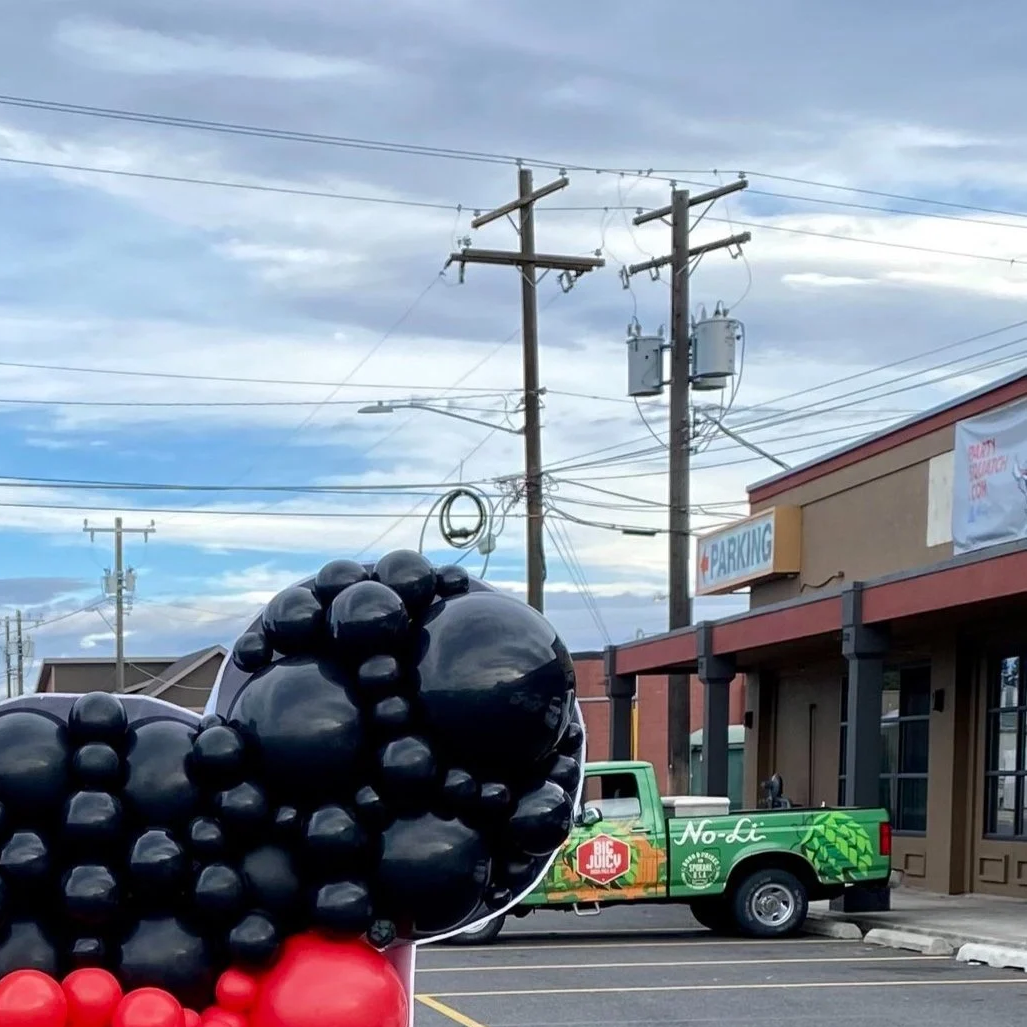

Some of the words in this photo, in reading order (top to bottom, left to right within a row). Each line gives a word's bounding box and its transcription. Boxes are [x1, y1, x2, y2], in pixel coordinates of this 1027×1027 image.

[710, 523, 772, 580] PARKING
[593, 840, 614, 856] BIG
[585, 853, 622, 869] JUICY
